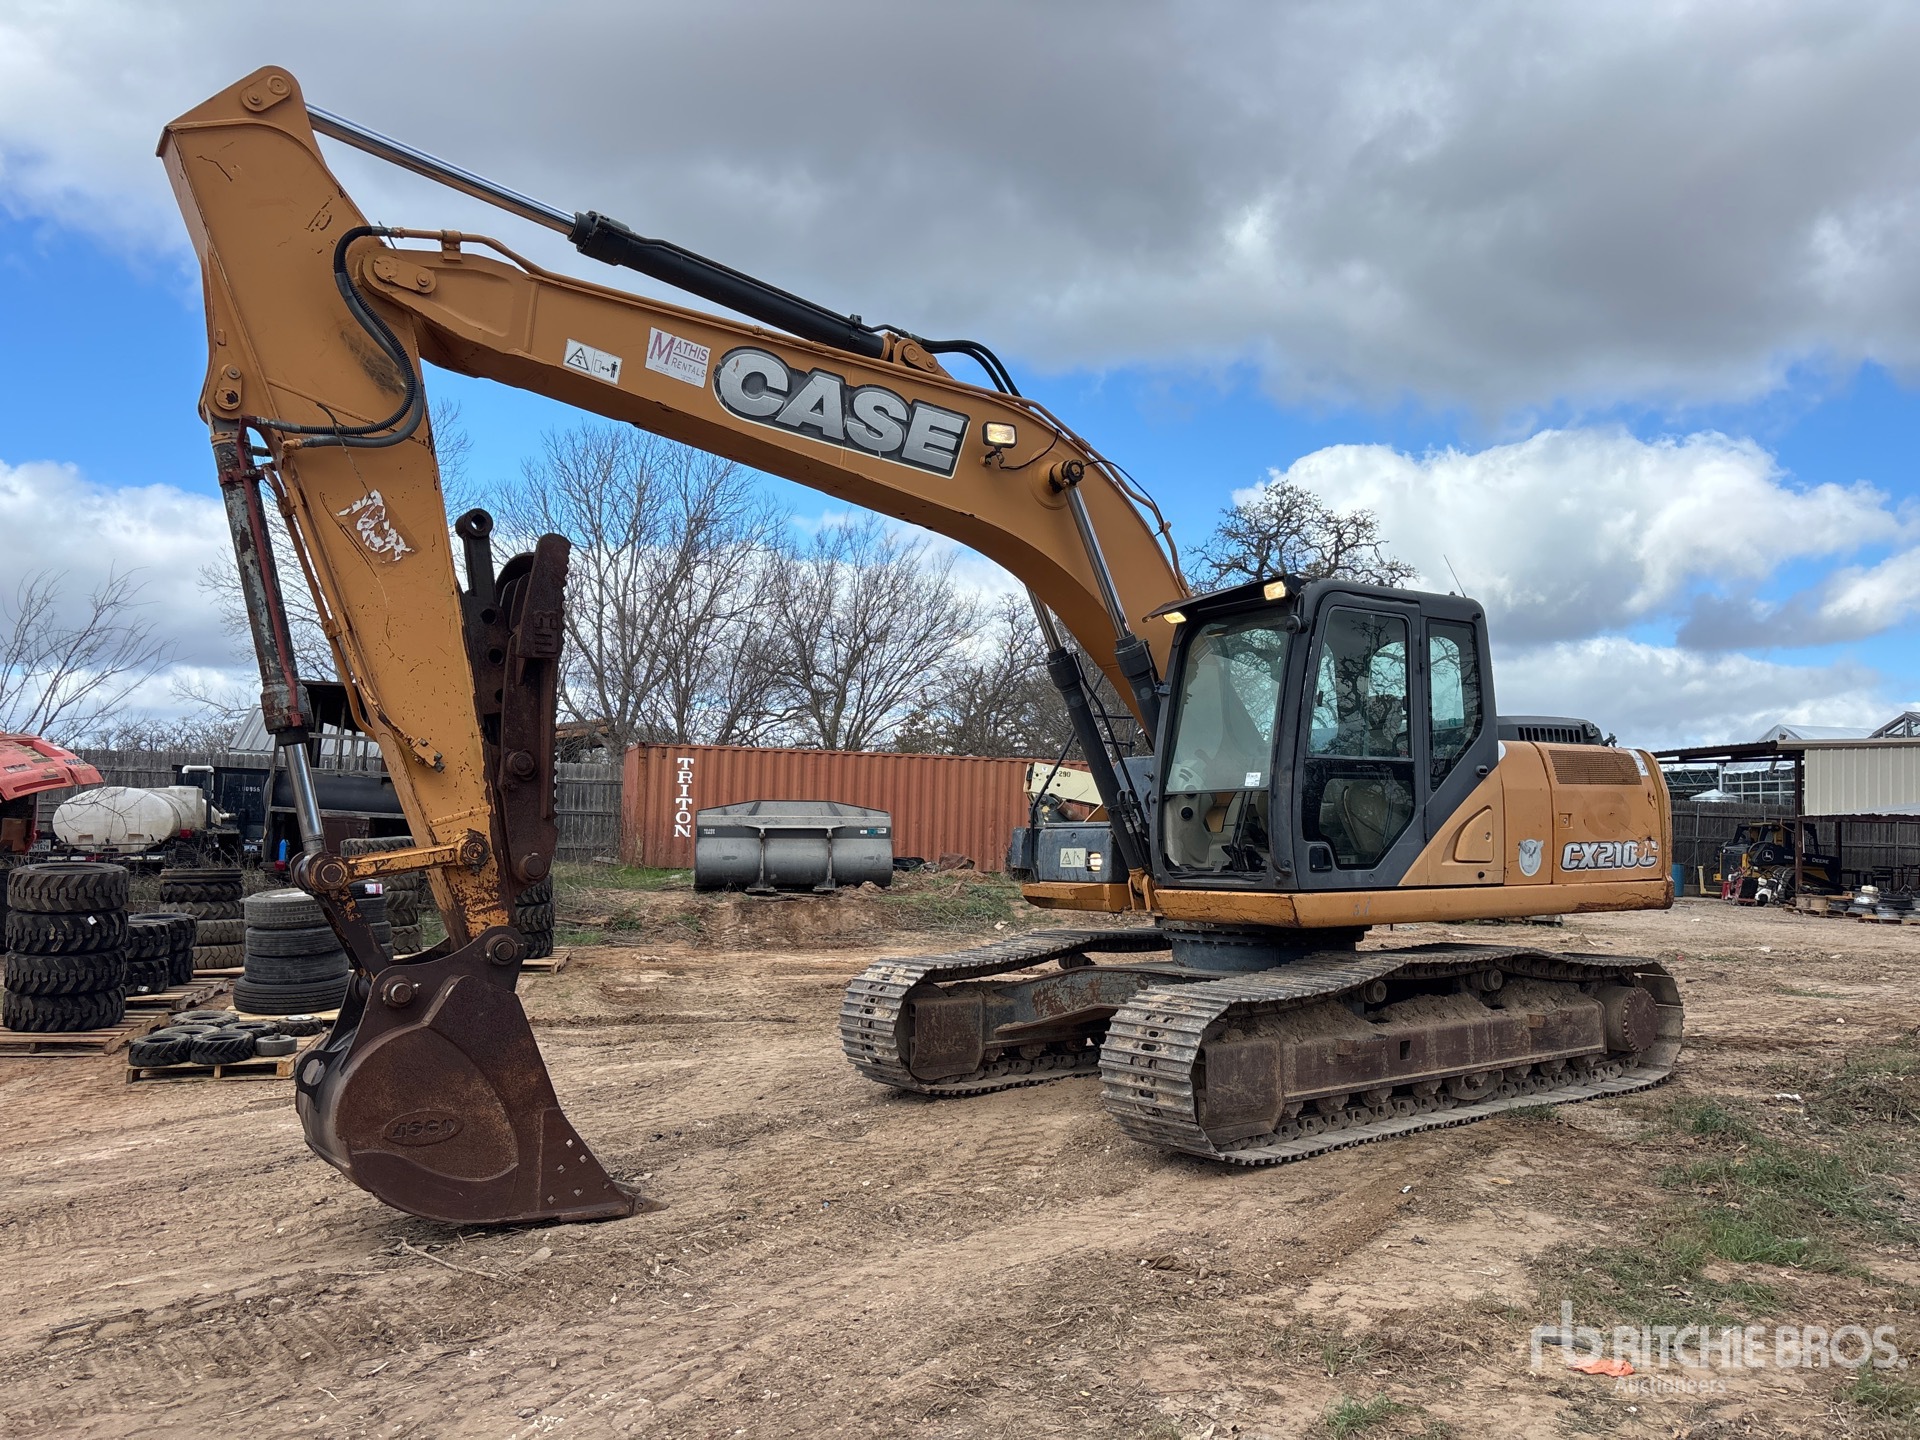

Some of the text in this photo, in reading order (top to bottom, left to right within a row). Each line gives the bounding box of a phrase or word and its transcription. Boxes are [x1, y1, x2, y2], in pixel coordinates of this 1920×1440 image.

[649, 331, 708, 363] MATHIS
[671, 357, 706, 378] RENTALS
[716, 349, 968, 474] CASE
[674, 757, 695, 838] TRITON
[1811, 857, 1830, 865] DEERE
